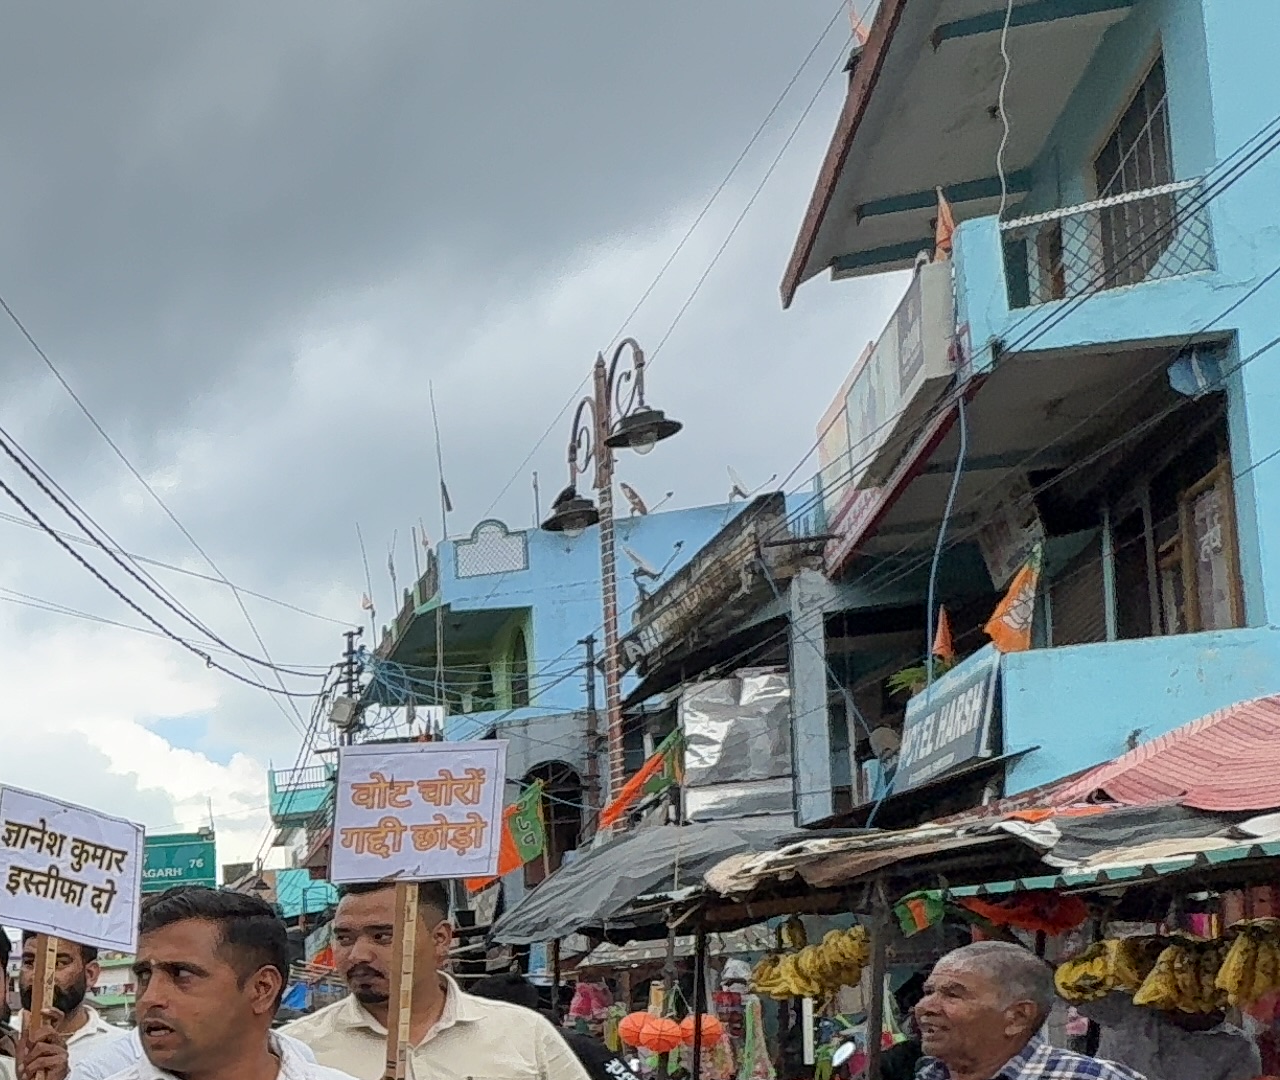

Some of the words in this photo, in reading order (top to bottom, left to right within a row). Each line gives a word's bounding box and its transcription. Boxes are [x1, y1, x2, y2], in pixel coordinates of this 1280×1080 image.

[350, 771, 415, 809] वोट
[417, 767, 486, 806] चोरों
[1, 817, 67, 858] ज्ञानेश
[70, 837, 128, 874] कुमार
[340, 815, 408, 859] गद्दी
[410, 811, 488, 856] छोड़ो
[189, 858, 204, 869] 76
[5, 865, 88, 908] इस्तीफा
[90, 879, 117, 915] दो
